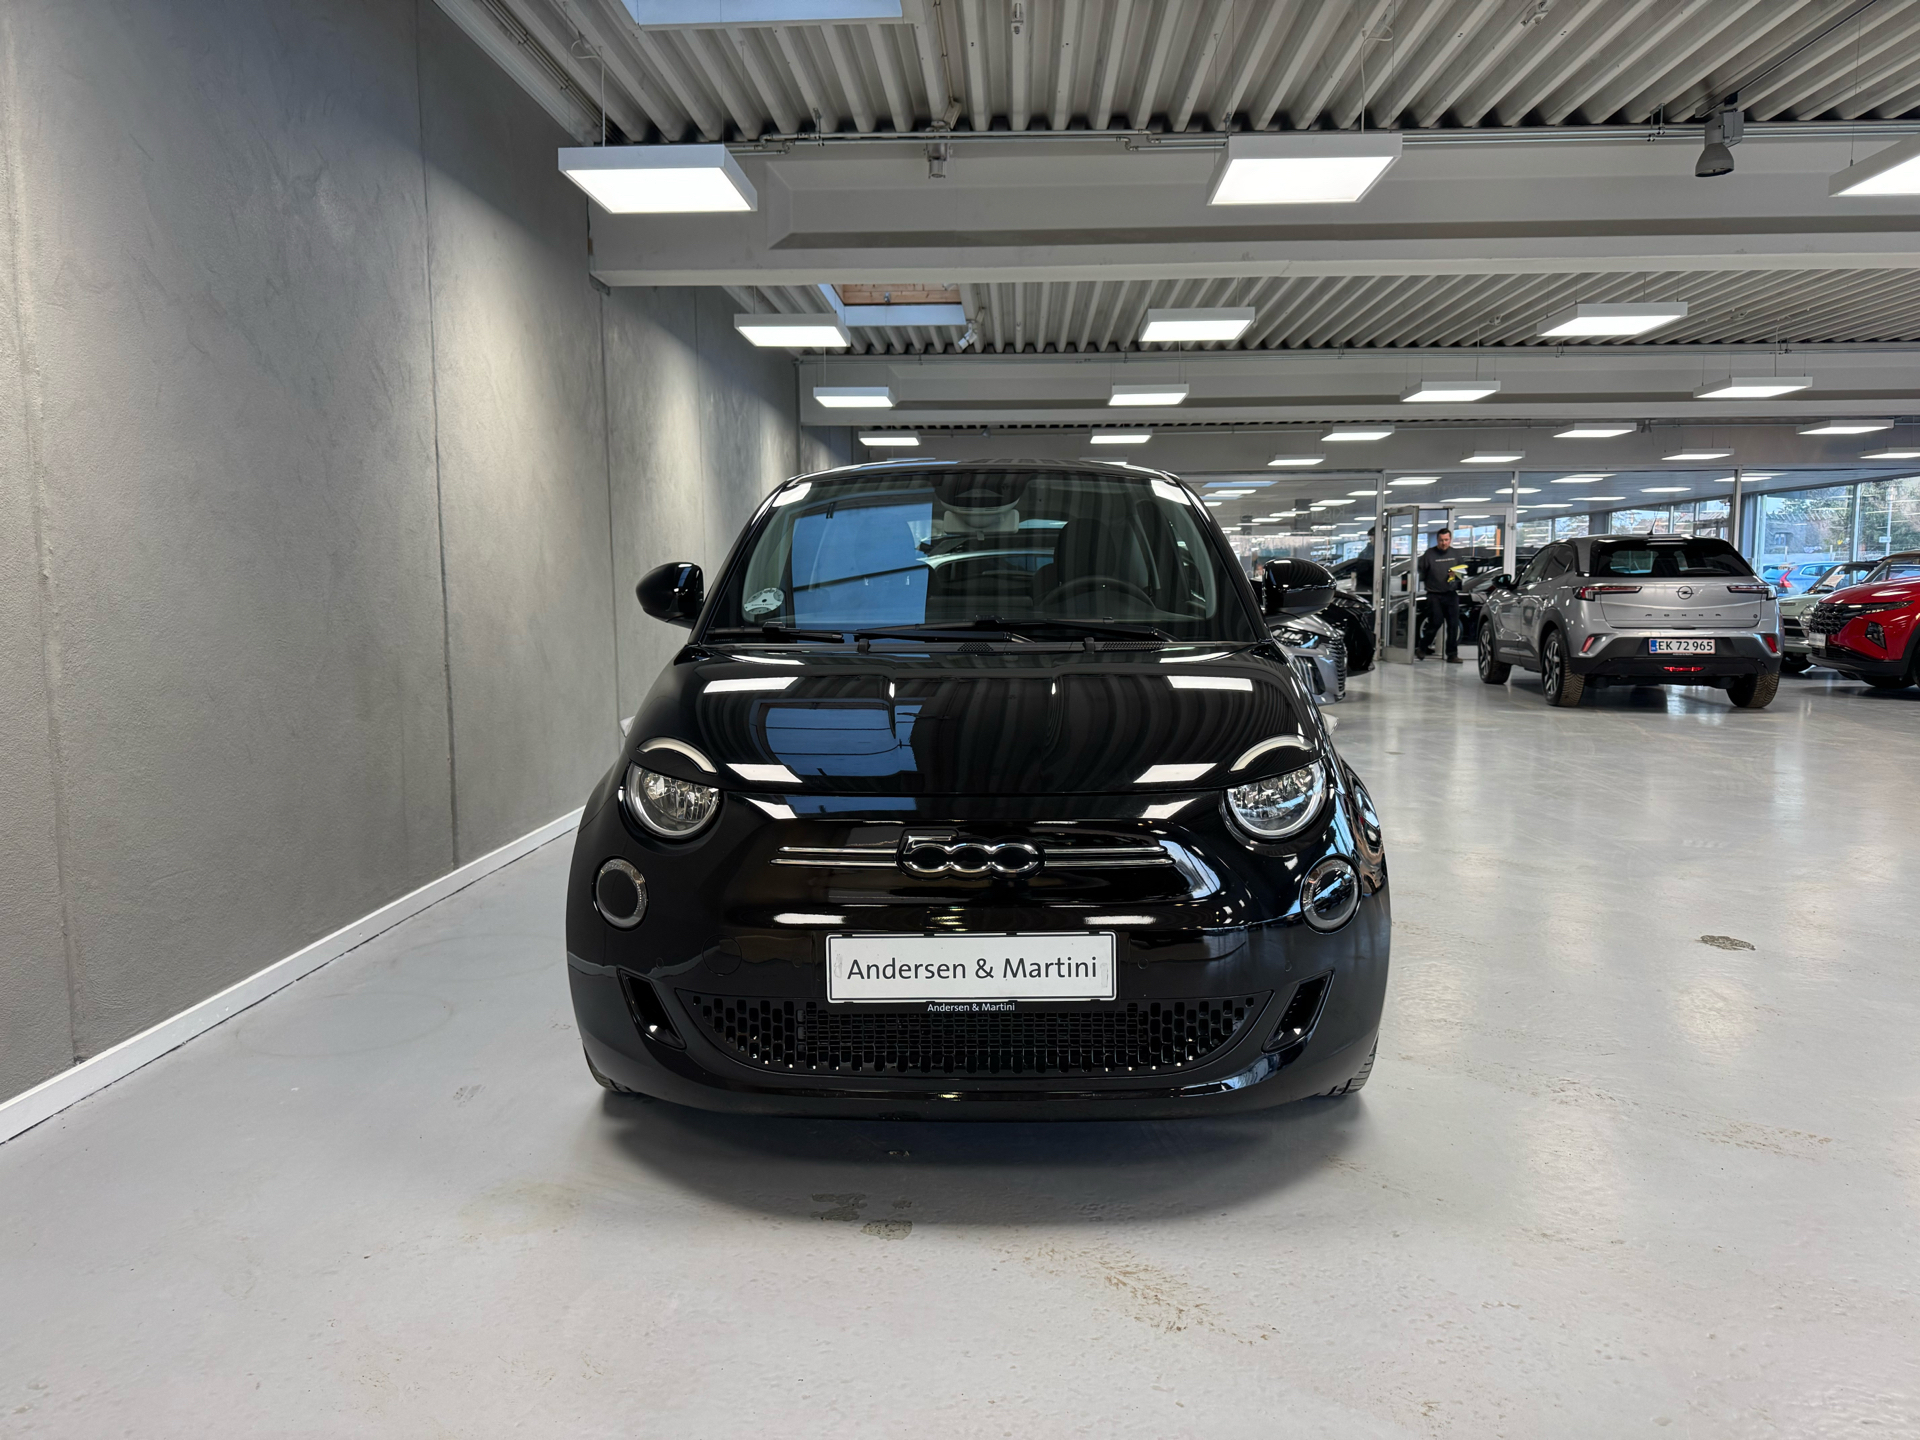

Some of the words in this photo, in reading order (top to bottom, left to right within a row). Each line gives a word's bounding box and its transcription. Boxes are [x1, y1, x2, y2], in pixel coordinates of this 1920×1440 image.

[1658, 640, 1673, 651] EK
[1675, 640, 1690, 651] 72
[1692, 640, 1713, 651] 965
[847, 957, 967, 980] Andersen
[974, 957, 995, 980] &
[1002, 956, 1098, 979] Martini
[927, 1002, 970, 1012] Andersen
[971, 1002, 980, 1012] &
[981, 1002, 1016, 1012] Martini
